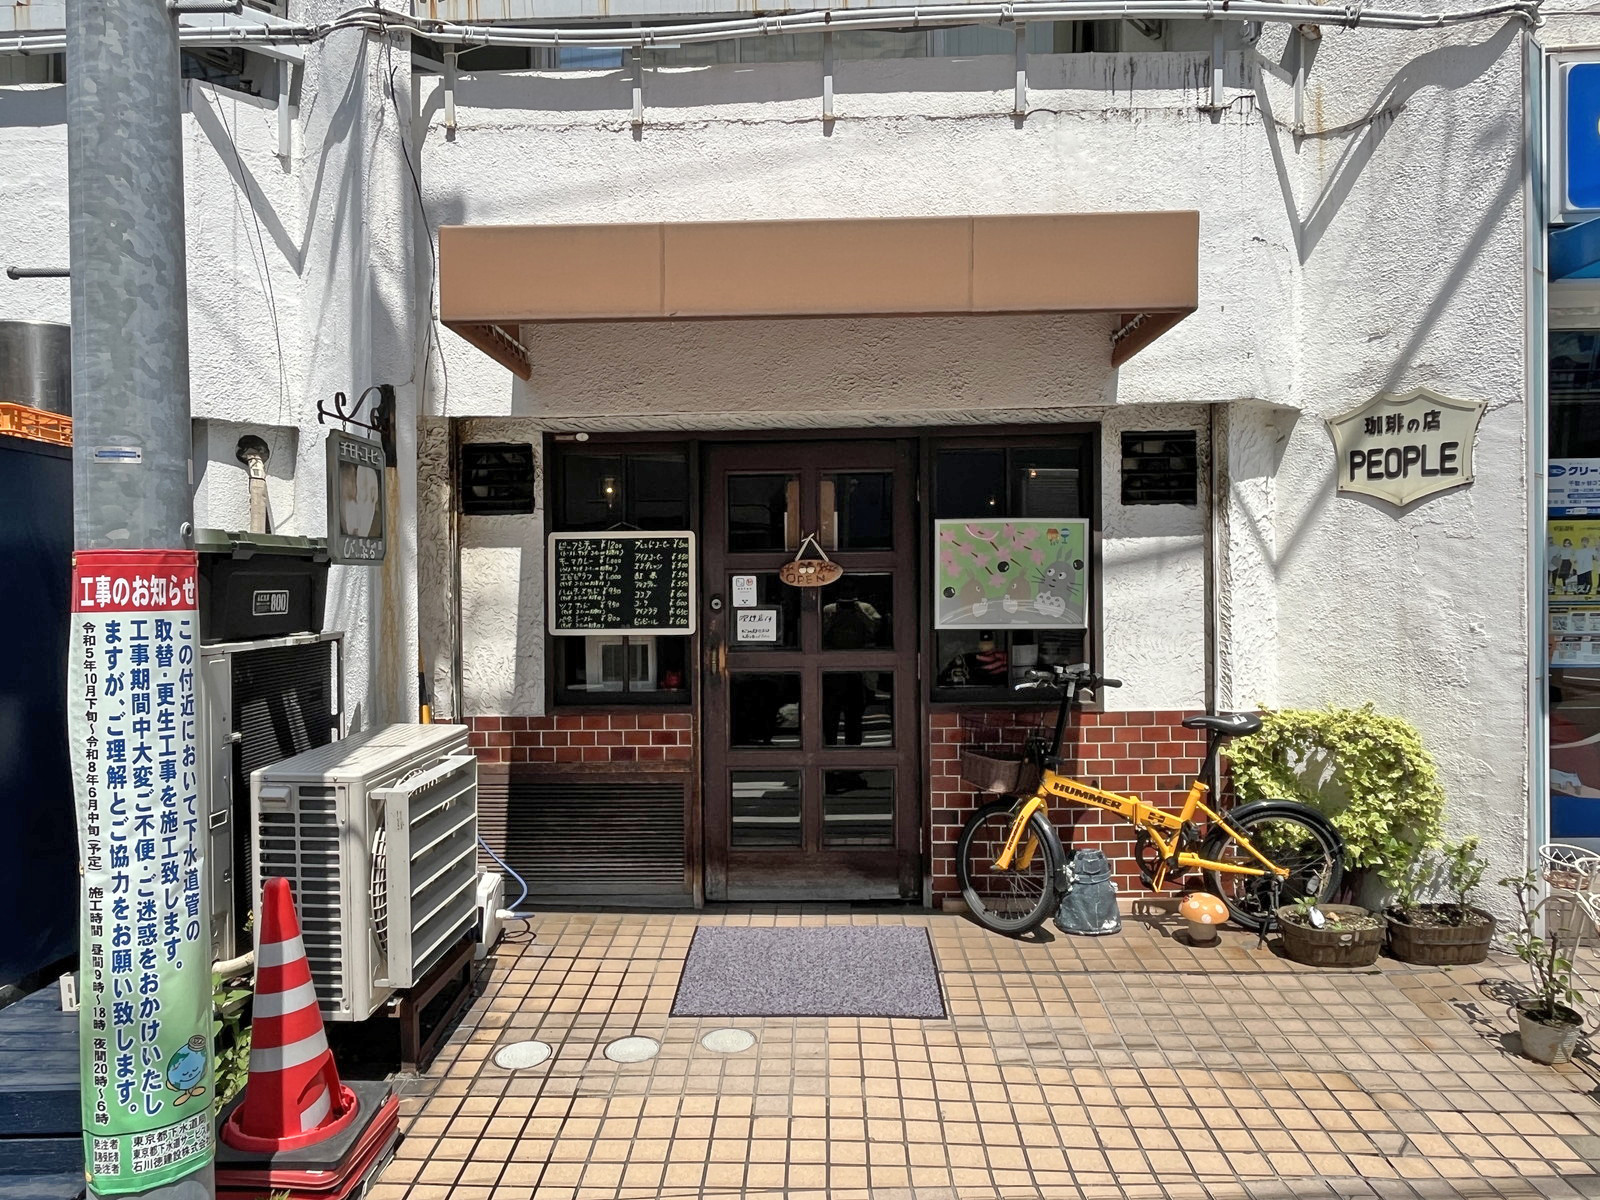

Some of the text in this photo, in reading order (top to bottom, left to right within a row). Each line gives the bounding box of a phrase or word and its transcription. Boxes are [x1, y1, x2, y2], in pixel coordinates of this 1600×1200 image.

[1364, 410, 1441, 435] 珈琲の店
[1350, 441, 1459, 481] PEOPLE
[1568, 466, 1600, 476] クリー
[80, 575, 195, 608] 工事のお知らせ
[786, 573, 826, 585] OPEN
[271, 593, 287, 611] 800
[154, 619, 182, 969] 取替・更生工事を施工致します。
[178, 620, 200, 941] この付近において下水道管の
[1053, 782, 1122, 810] HUMMER
[105, 620, 137, 1113] ますが、ご理解とご協力をお願い致します。
[129, 620, 163, 1115] 工事期間中大変ご不便・ご迷惑をおかけいたし
[88, 887, 104, 937] 施工時間
[133, 1114, 207, 1147] 東京都下水道局
[133, 1124, 210, 1160] 東京都下水道サービス
